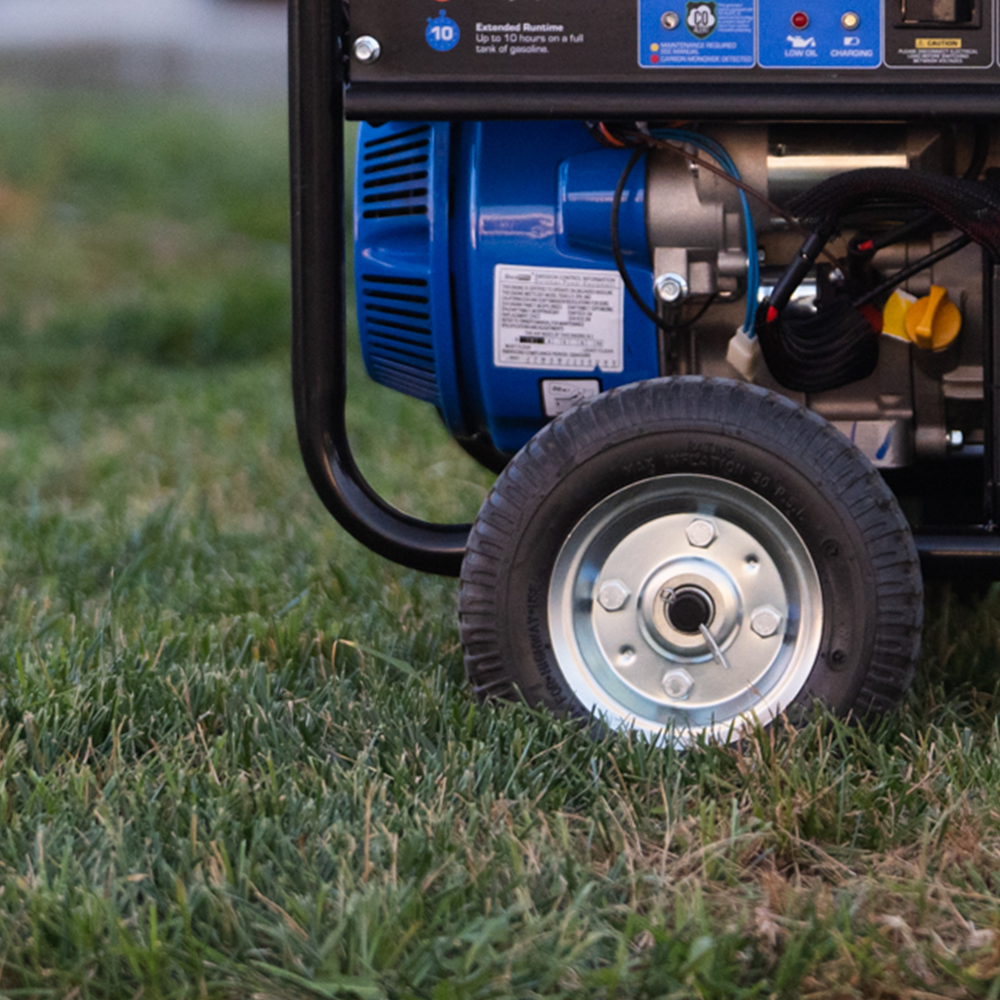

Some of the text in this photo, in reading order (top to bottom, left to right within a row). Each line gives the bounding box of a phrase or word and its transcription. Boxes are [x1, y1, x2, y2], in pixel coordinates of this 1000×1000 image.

[476, 23, 564, 32] Extended Runtime
[430, 26, 453, 41] 10
[476, 34, 490, 44] Up
[491, 34, 502, 42] to
[504, 34, 517, 42] 10
[519, 34, 546, 42] hours
[570, 34, 584, 42] full
[476, 45, 496, 53] tank
[498, 45, 508, 53] of
[784, 49, 818, 57] LOW OIL
[830, 49, 873, 57] CHARGING
